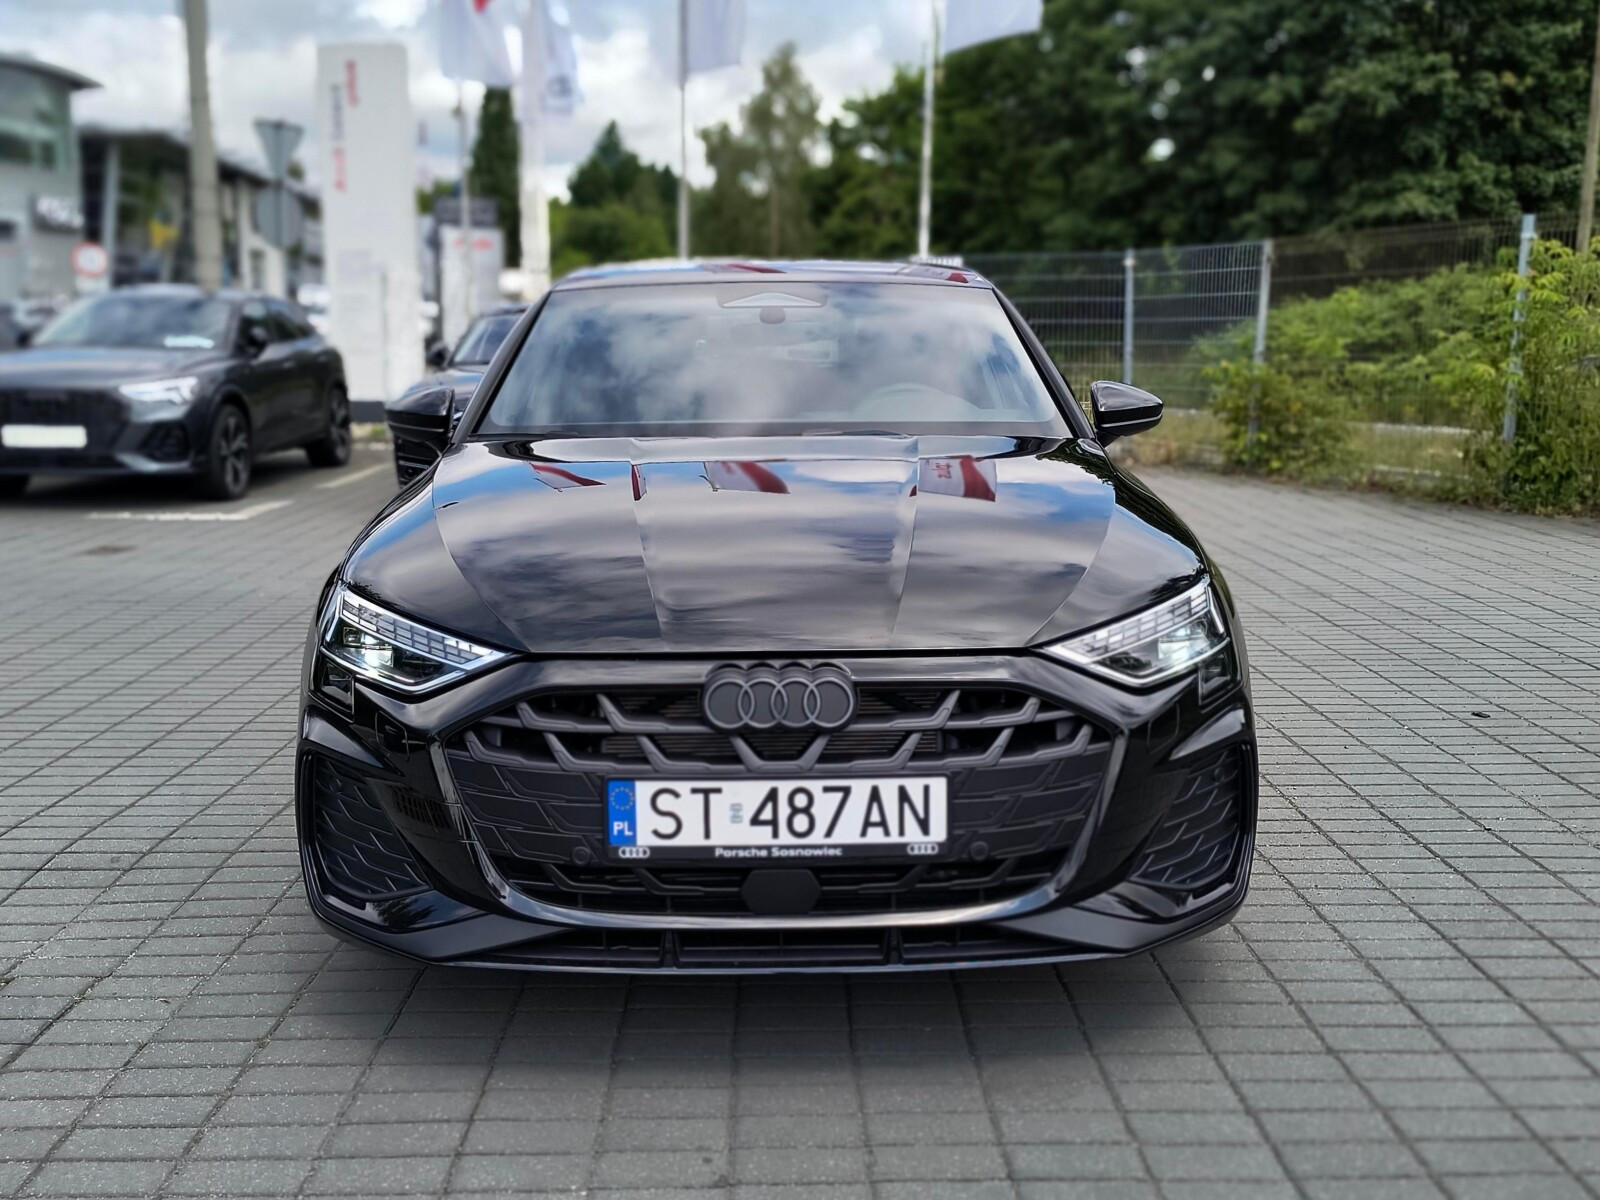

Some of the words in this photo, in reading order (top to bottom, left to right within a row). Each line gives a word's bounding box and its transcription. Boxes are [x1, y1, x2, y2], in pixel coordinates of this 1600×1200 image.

[650, 787, 722, 840] ST
[749, 784, 931, 839] 487AN
[613, 821, 633, 836] PL
[715, 847, 768, 857] Porsche
[771, 846, 843, 857] Sosnowiec
